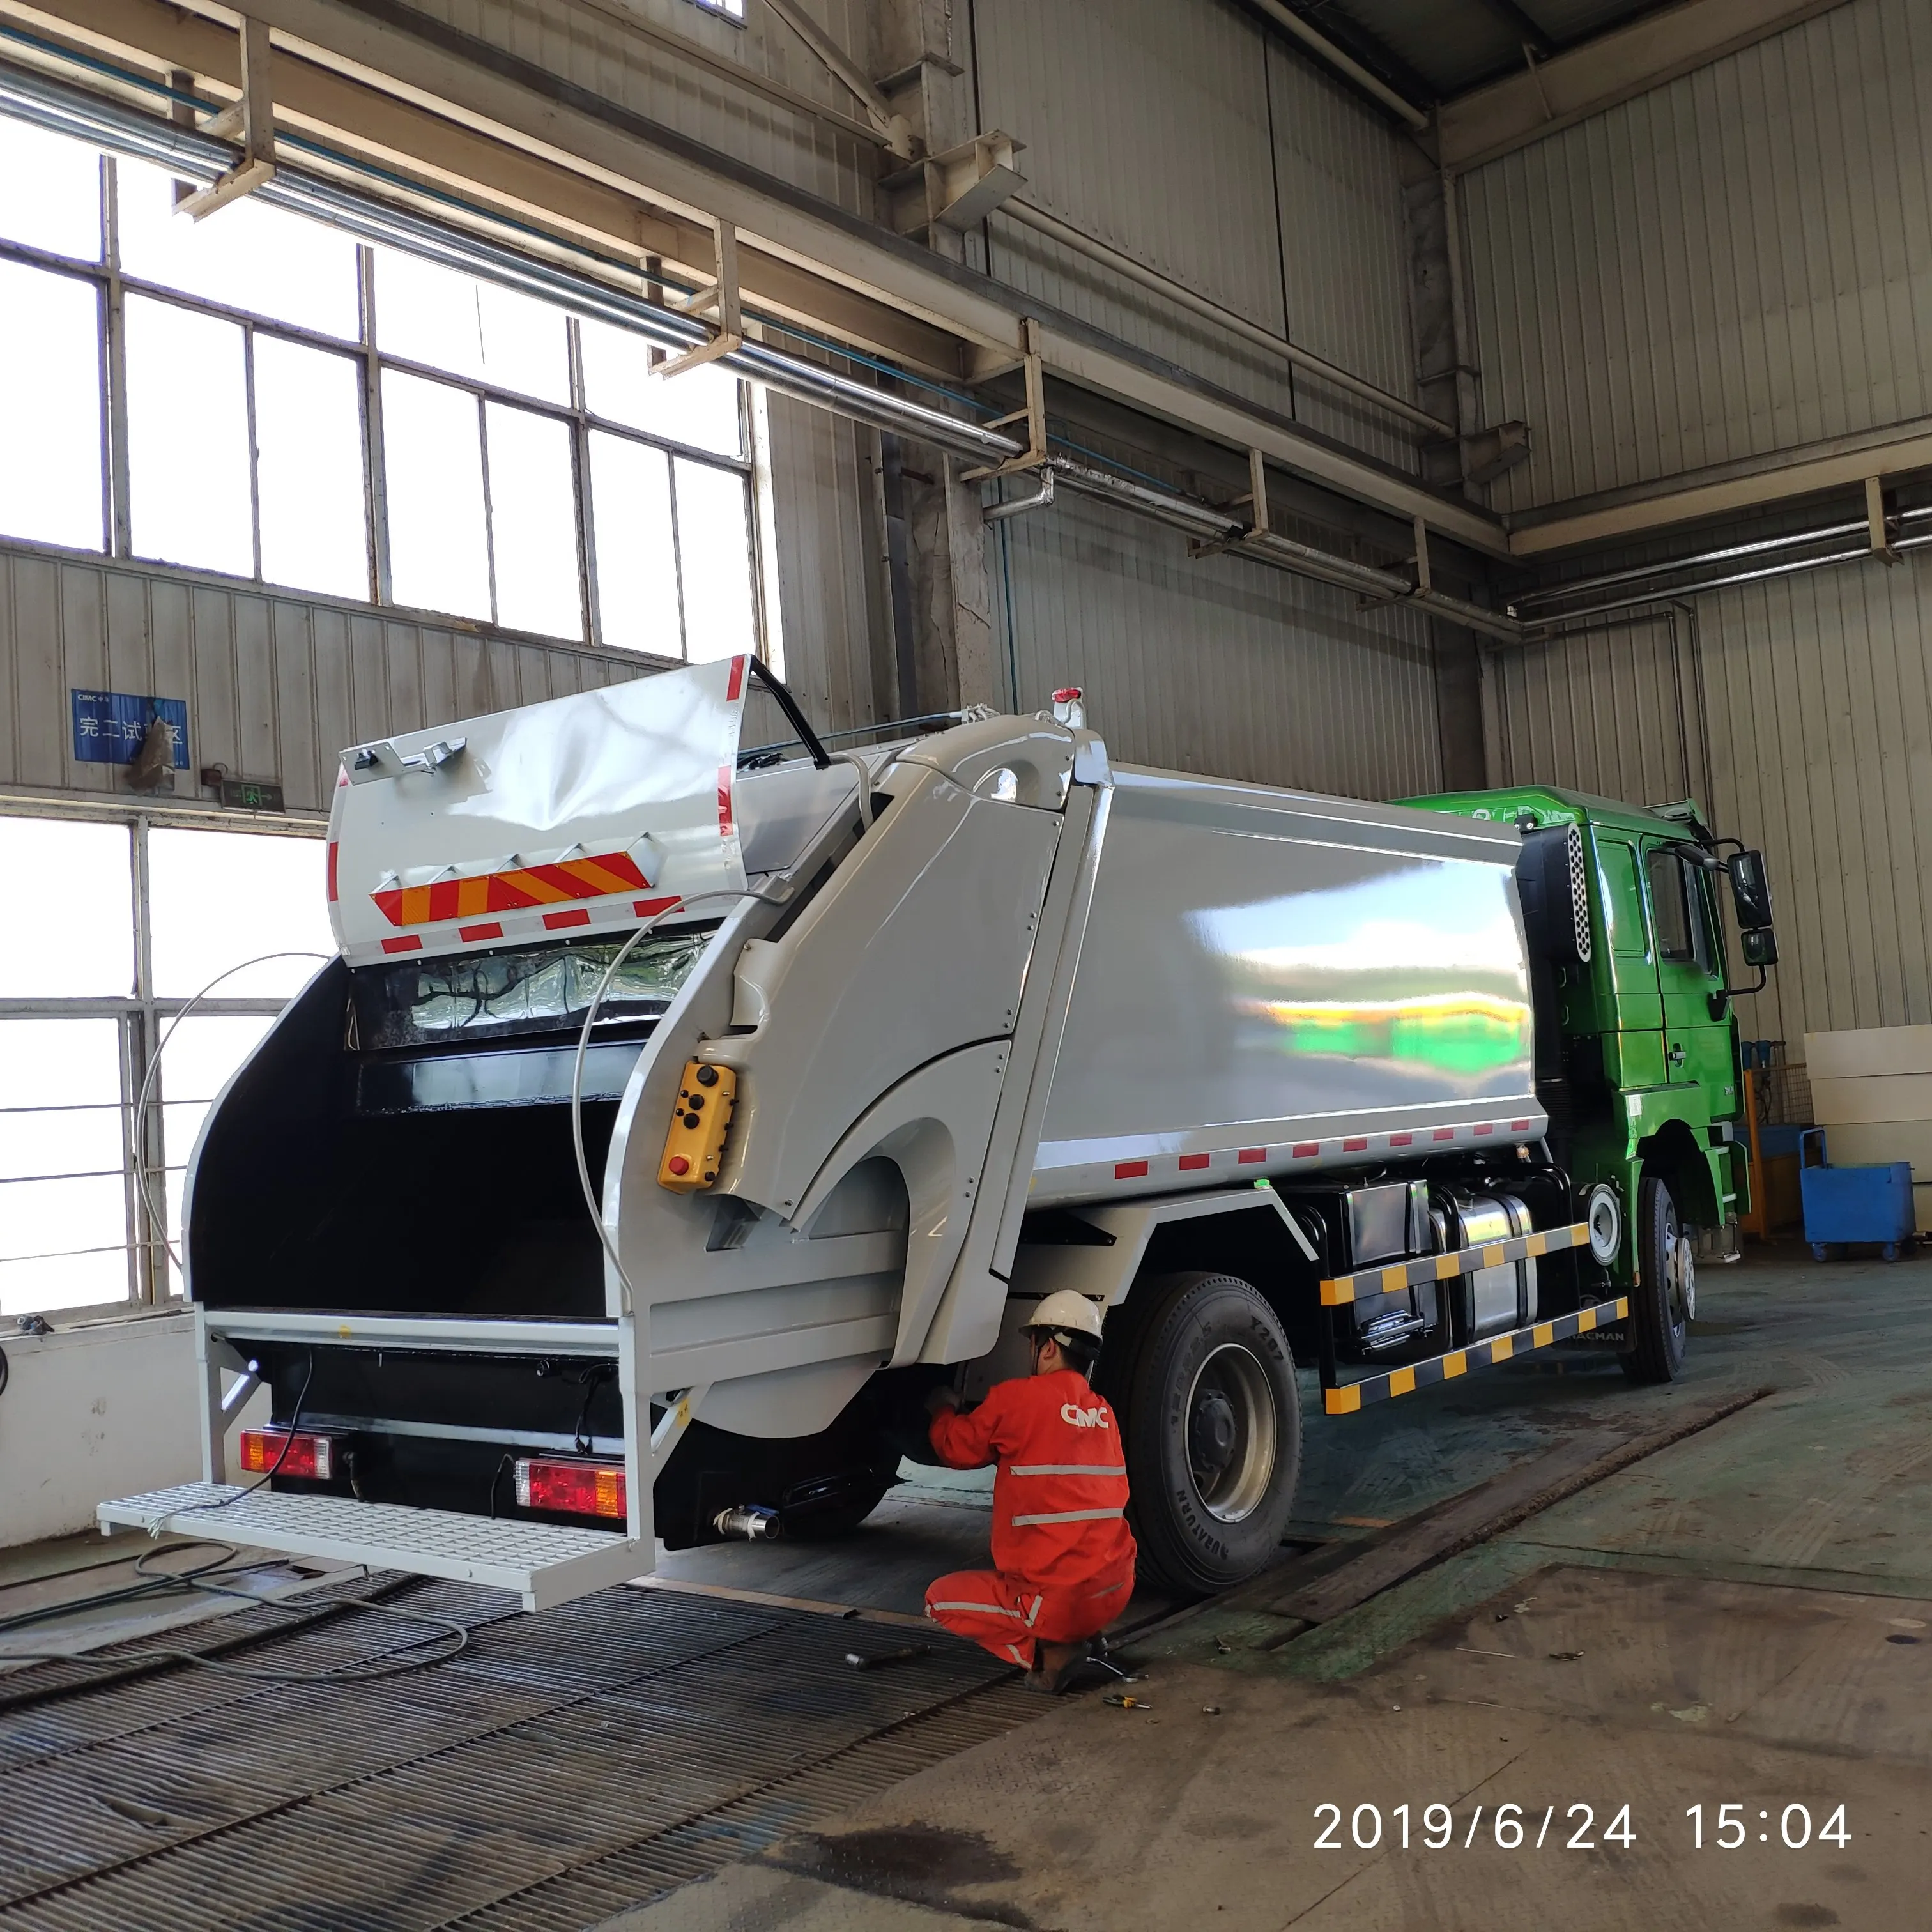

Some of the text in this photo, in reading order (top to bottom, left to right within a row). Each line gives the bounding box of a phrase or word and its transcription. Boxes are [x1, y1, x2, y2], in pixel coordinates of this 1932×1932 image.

[77, 694, 97, 702] CIMC
[80, 716, 183, 744] 完二试区
[1568, 1332, 1625, 1341] ACMAN
